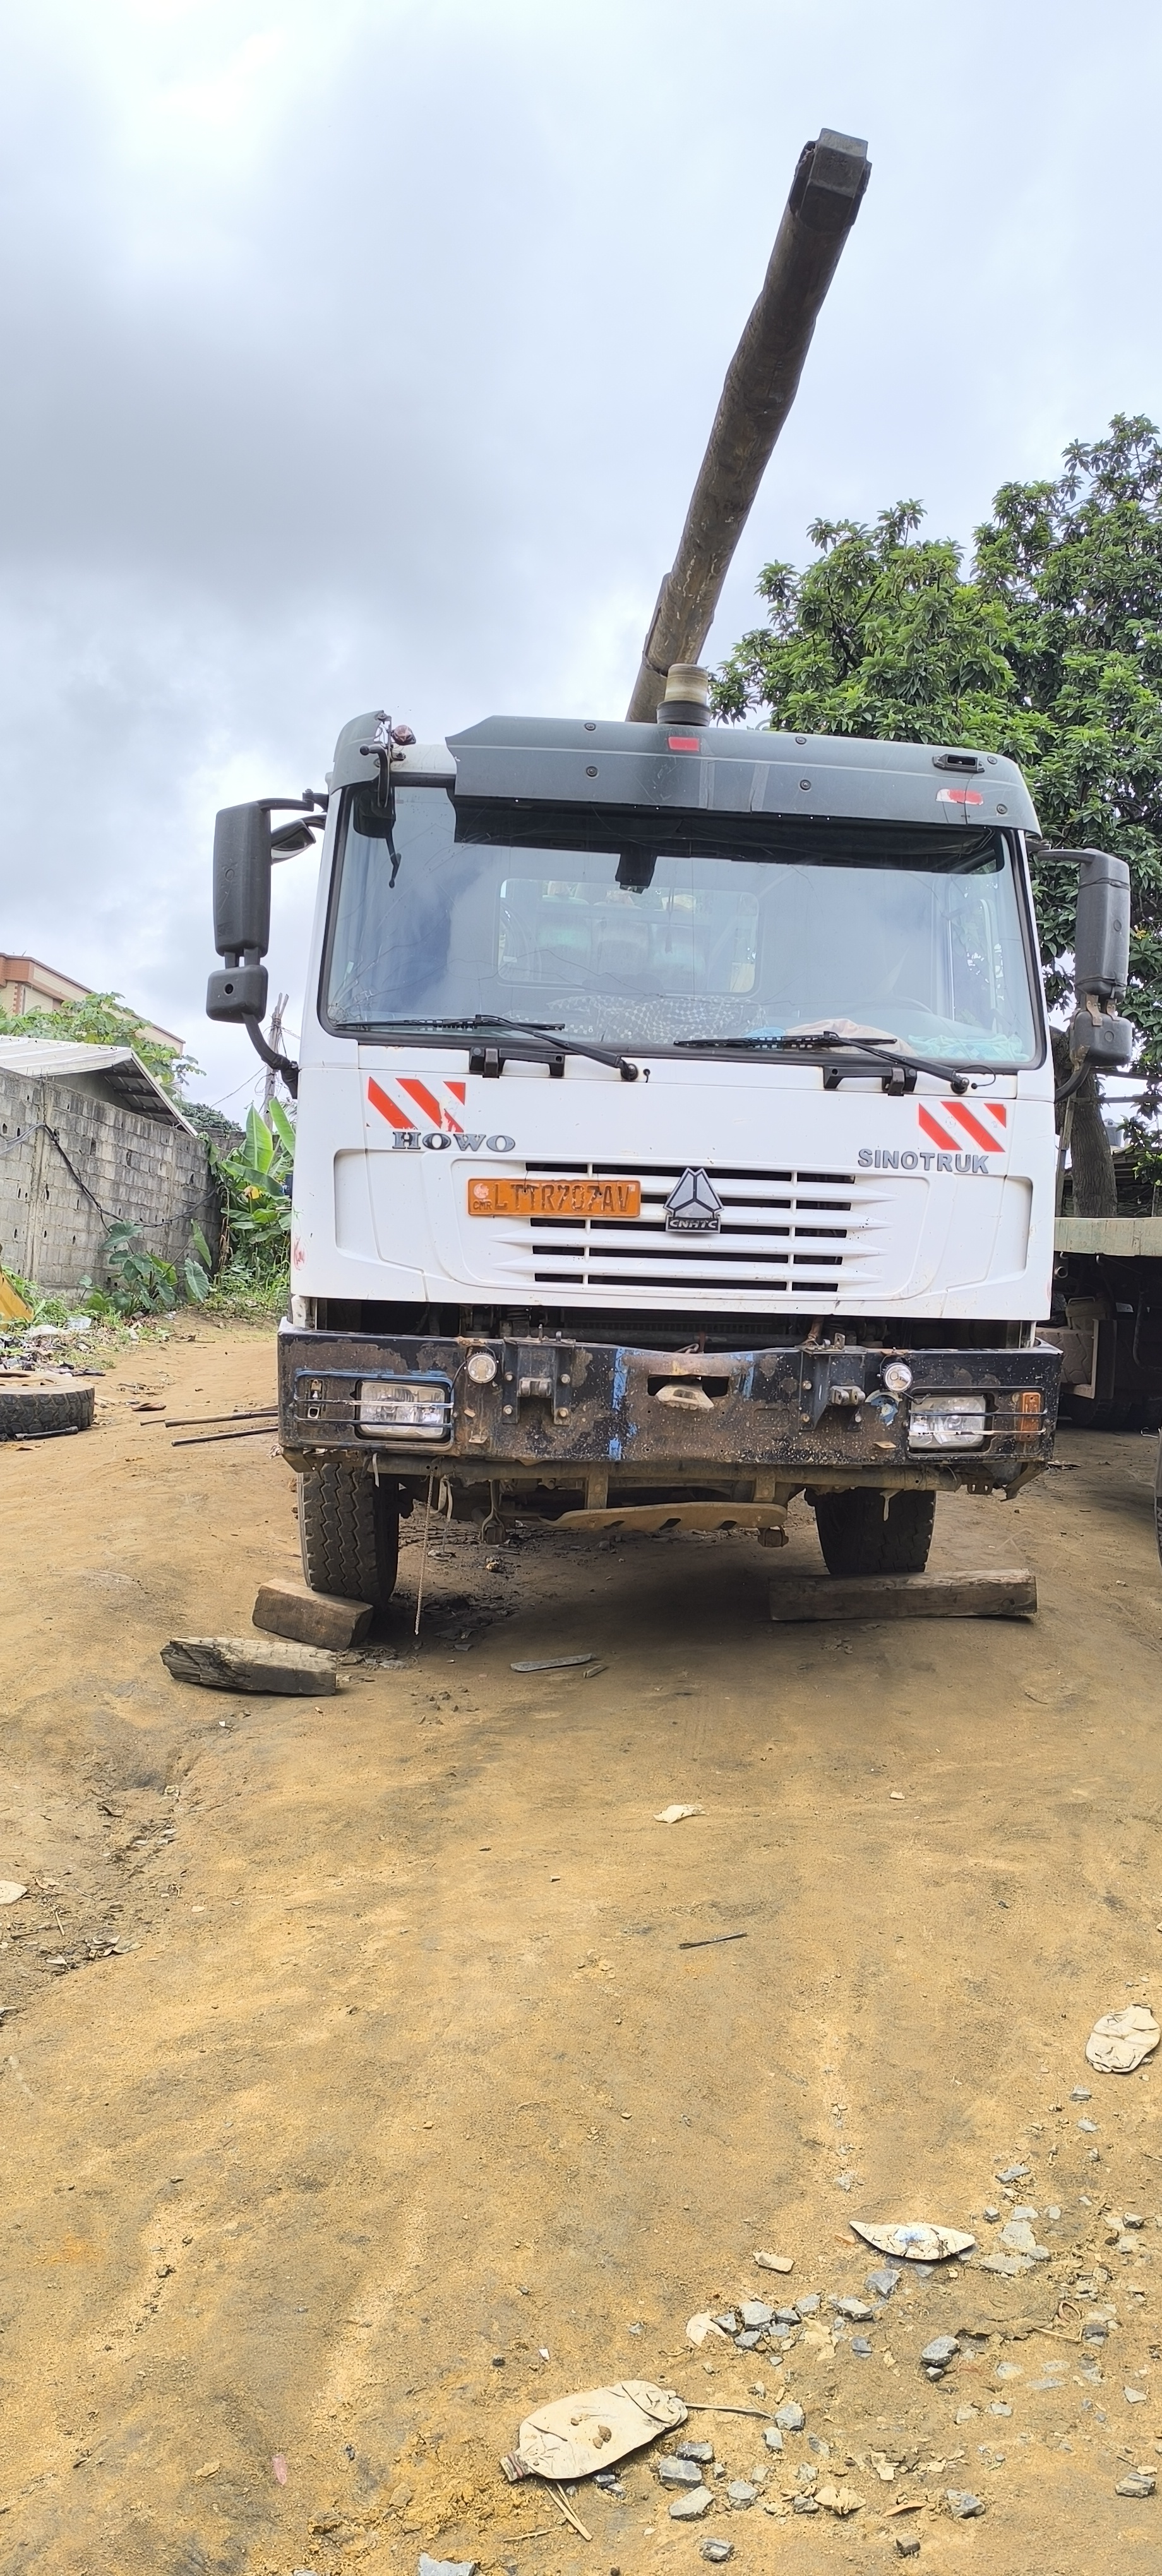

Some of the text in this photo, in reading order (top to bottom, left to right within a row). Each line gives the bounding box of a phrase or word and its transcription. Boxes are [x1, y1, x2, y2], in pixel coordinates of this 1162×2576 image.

[392, 1131, 515, 1152] HOWO
[858, 1148, 989, 1174] SINOTRUK
[473, 1200, 492, 1210] CMR
[669, 1219, 717, 1228] CNHTC
